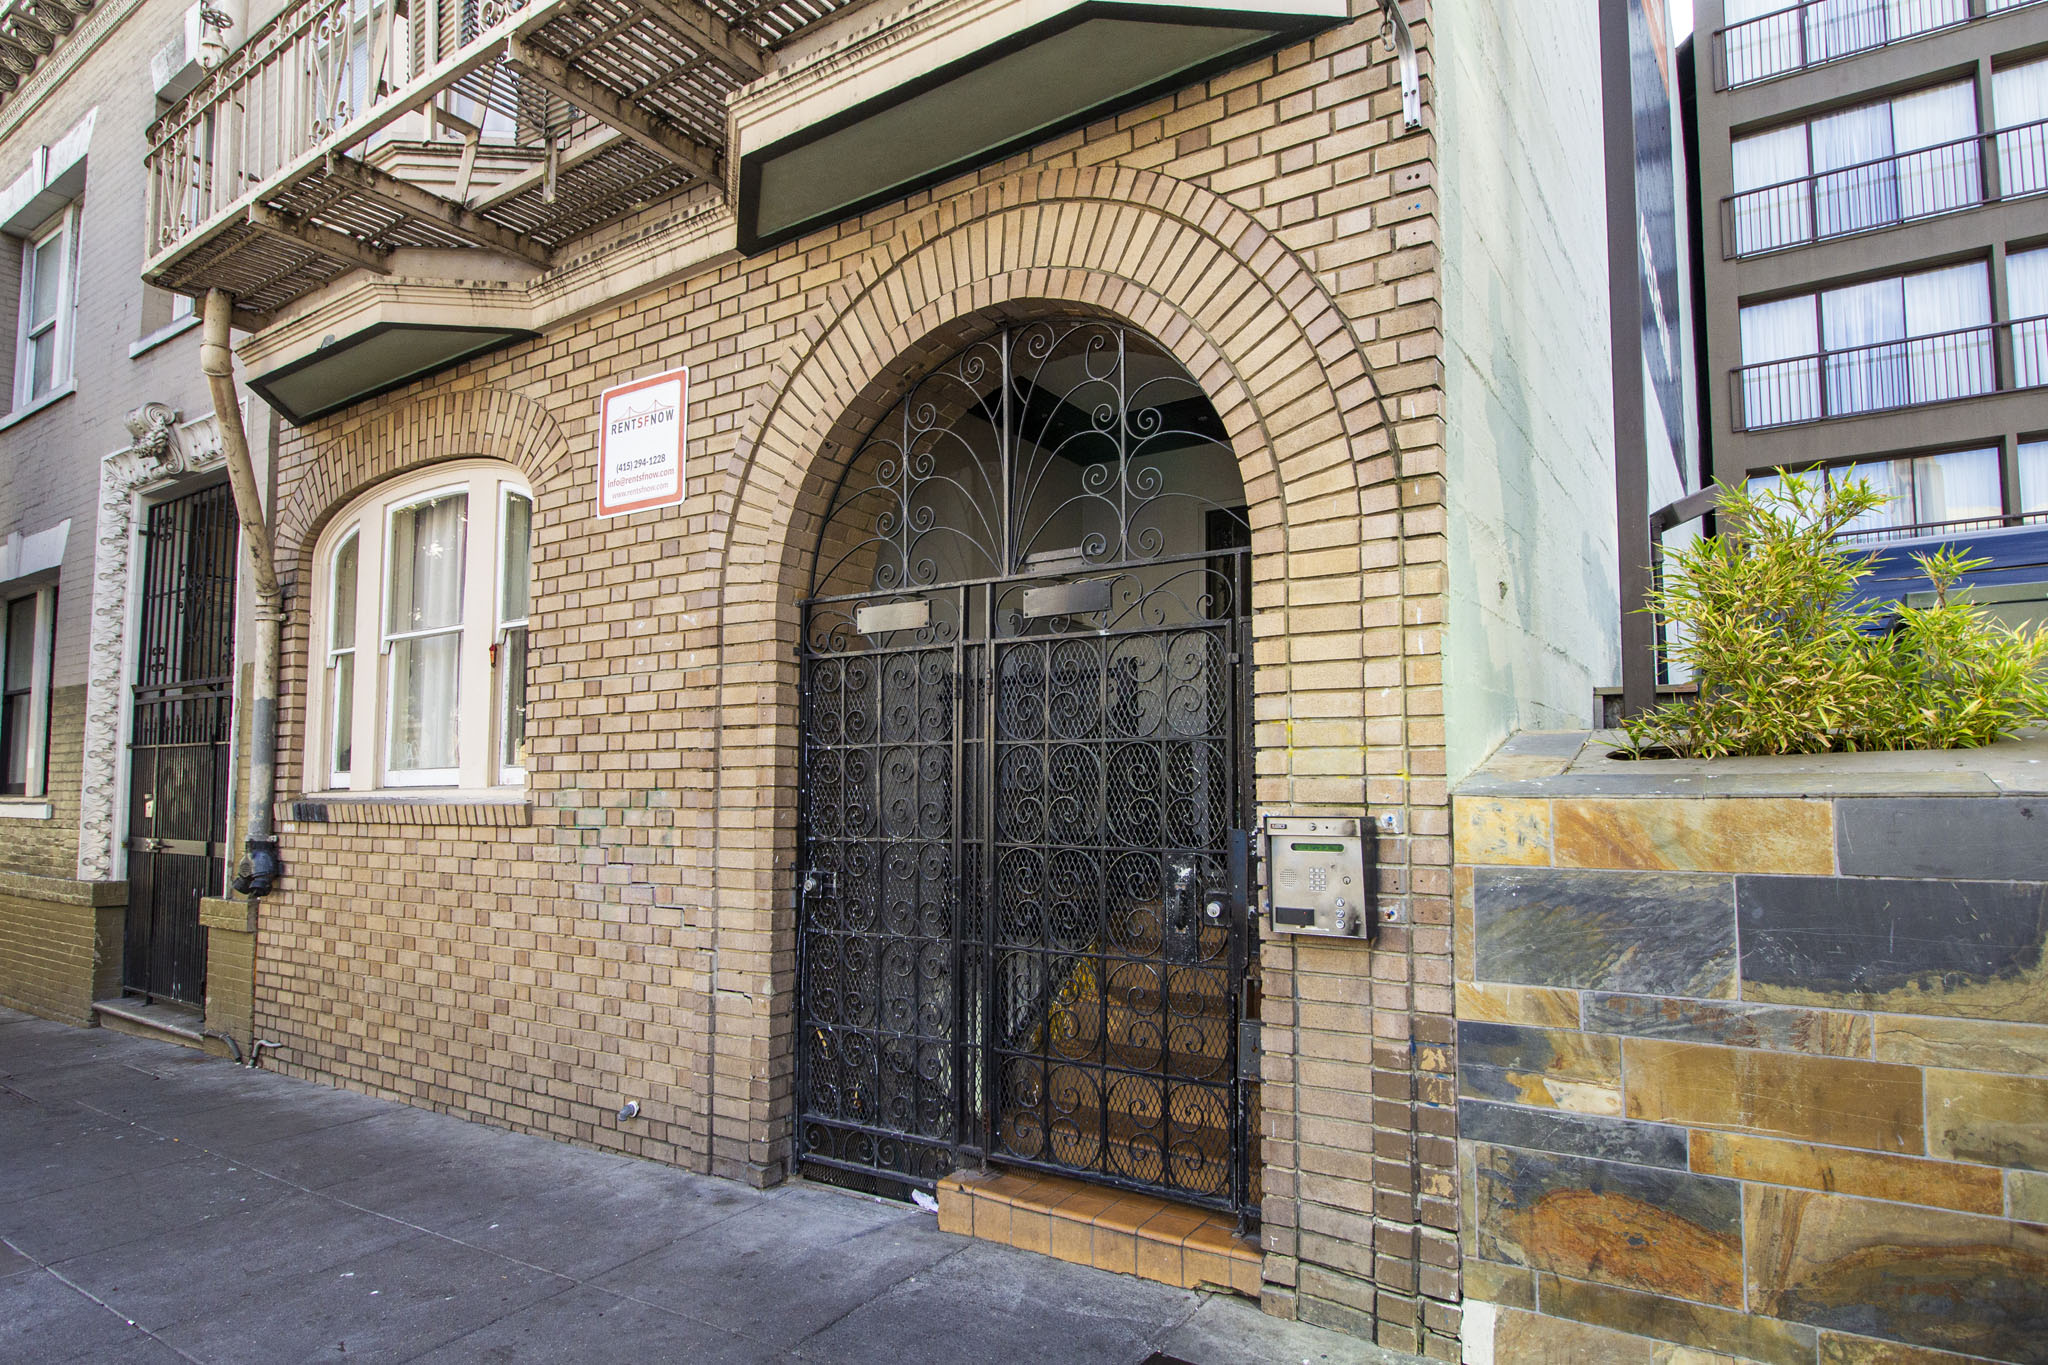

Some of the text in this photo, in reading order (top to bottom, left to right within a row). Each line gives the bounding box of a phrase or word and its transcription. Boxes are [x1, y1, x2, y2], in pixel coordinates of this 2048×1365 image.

[611, 409, 674, 435] RENTSFNOW
[616, 453, 666, 474] (415) 294-1228
[607, 467, 675, 488] info@rentsfnow.com
[612, 482, 669, 499] www.rentsfnow.com
